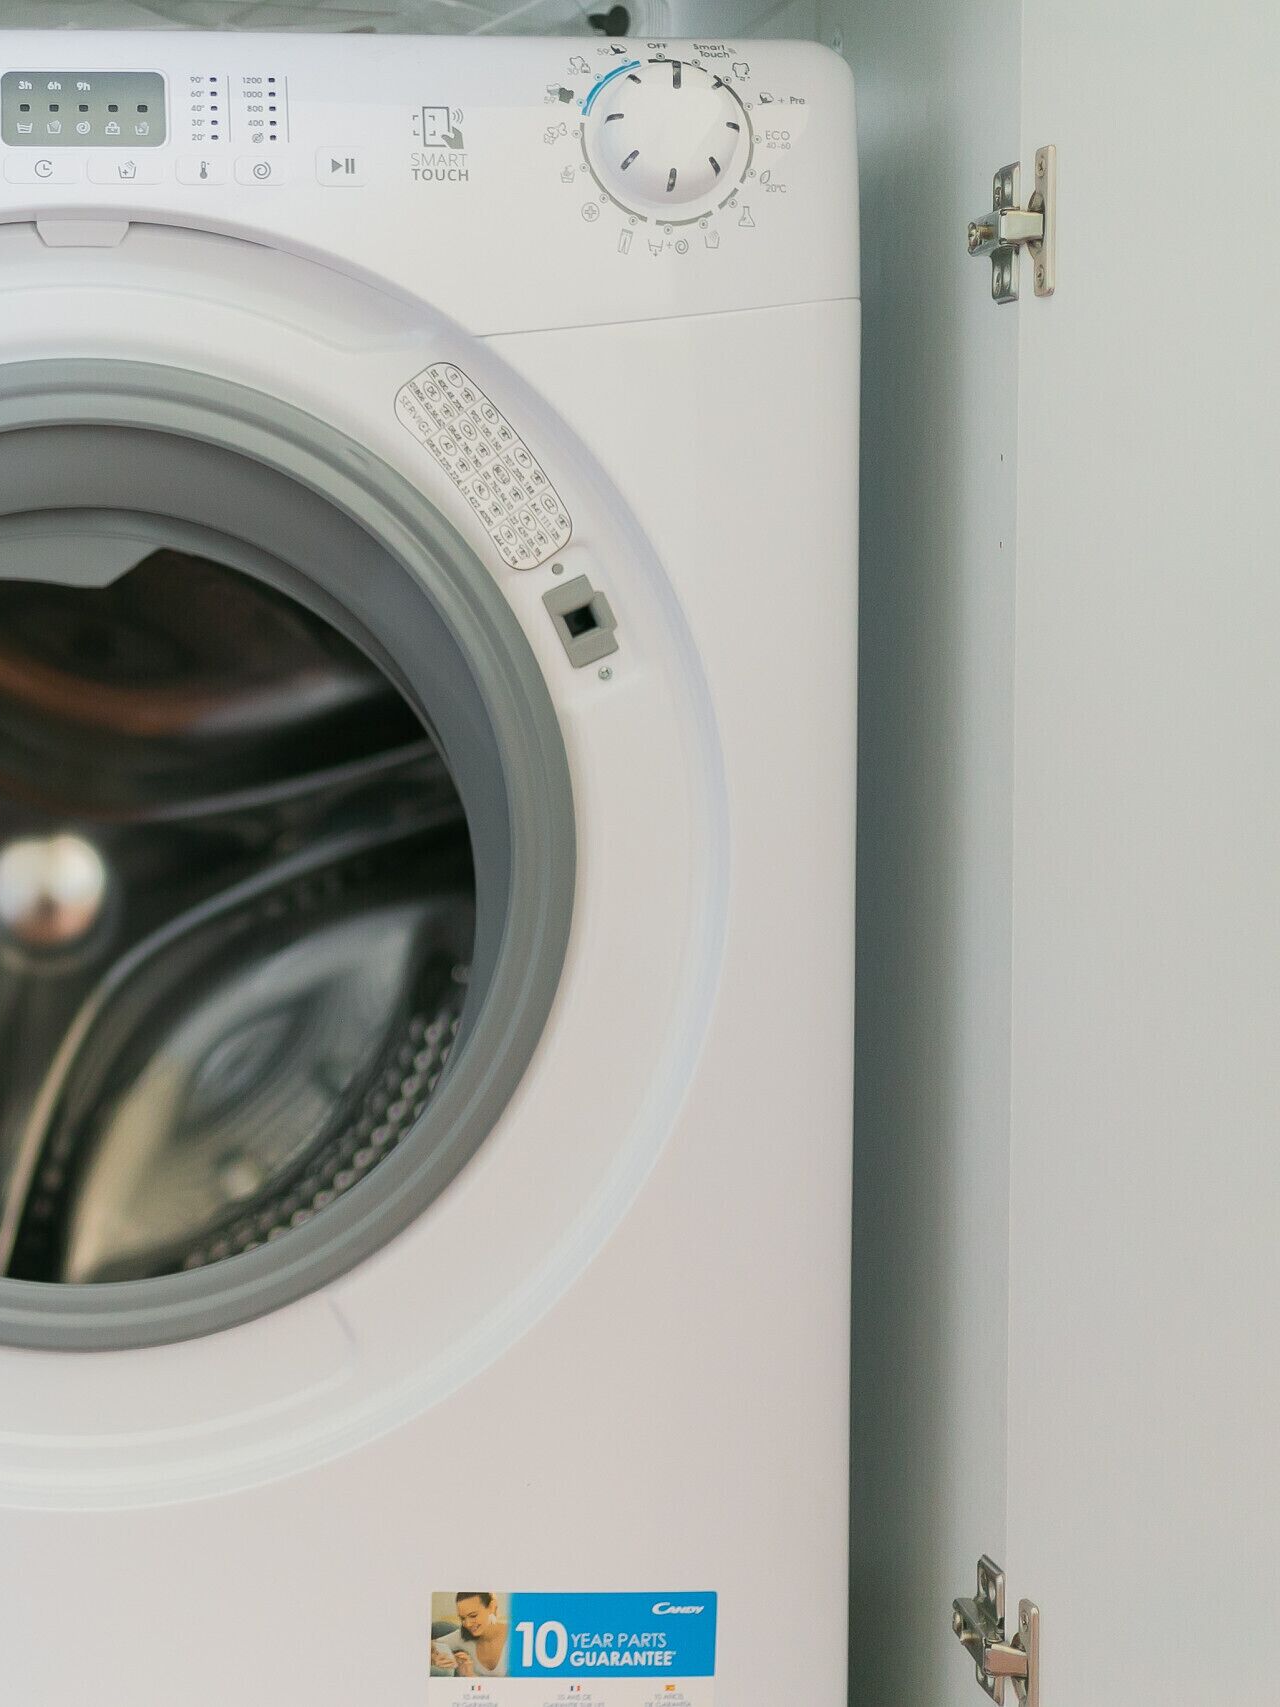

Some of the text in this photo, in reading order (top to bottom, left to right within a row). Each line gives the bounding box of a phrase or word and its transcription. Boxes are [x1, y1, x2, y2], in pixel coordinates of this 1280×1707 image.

[647, 42, 668, 50] OFF
[693, 42, 725, 51] Smart
[700, 50, 730, 58] Touch
[18, 81, 90, 91] 3h 6h 9h
[247, 119, 264, 127] 400
[765, 130, 791, 141] ECO
[411, 153, 468, 168] SMART
[412, 168, 470, 182] TOUCH
[515, 1620, 667, 1669] 10 YEAR PARTS
